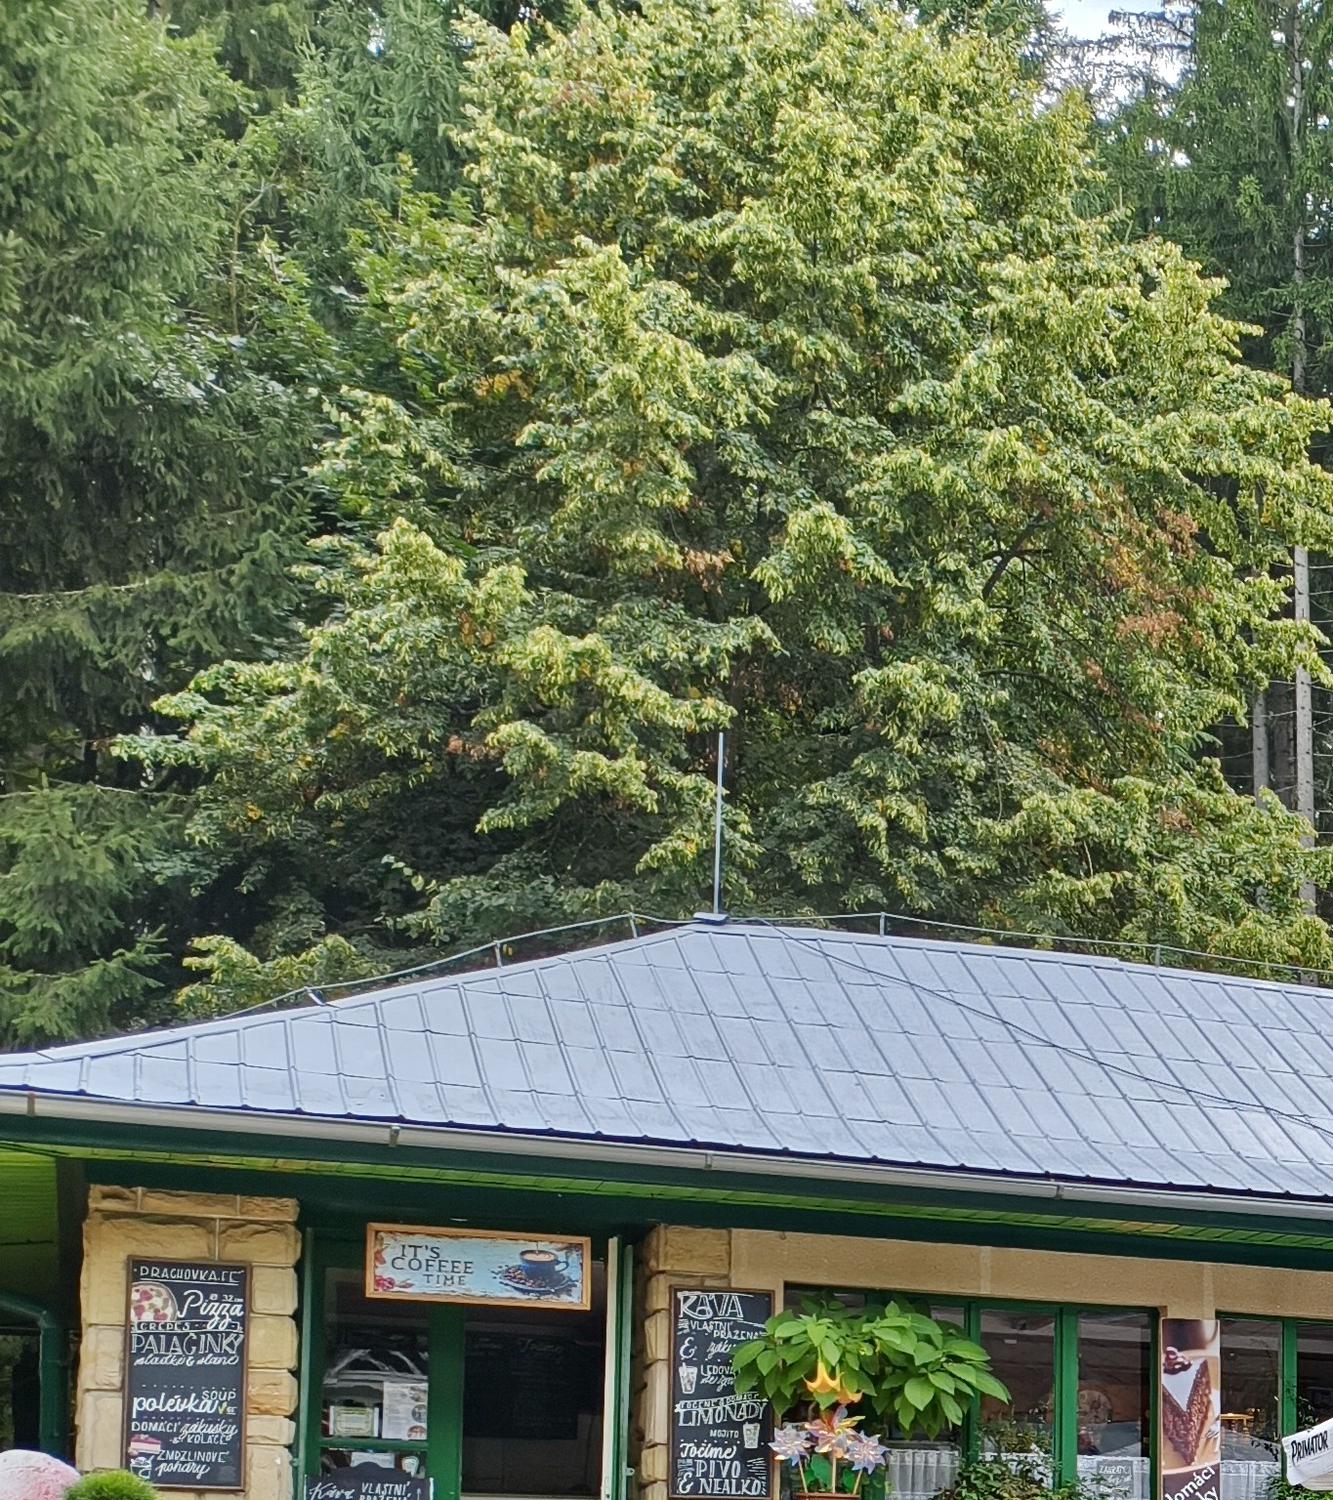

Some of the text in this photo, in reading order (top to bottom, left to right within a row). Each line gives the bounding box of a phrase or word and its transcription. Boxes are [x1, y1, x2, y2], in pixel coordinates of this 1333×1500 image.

[401, 1244, 441, 1258] IT'S
[391, 1257, 474, 1274] COFFEE
[423, 1274, 466, 1286] TIME
[177, 1290, 244, 1330] Pizza
[131, 1332, 244, 1356] PALAČINKY
[202, 1390, 236, 1401] SOUP
[132, 1392, 218, 1418] polévka
[131, 1421, 180, 1432] DOMÁCÍ
[710, 1429, 739, 1438] MOJITO
[1291, 1430, 1329, 1463] PRIMATOR
[694, 1459, 741, 1478] PIVO
[698, 1477, 761, 1495] NEALKO
